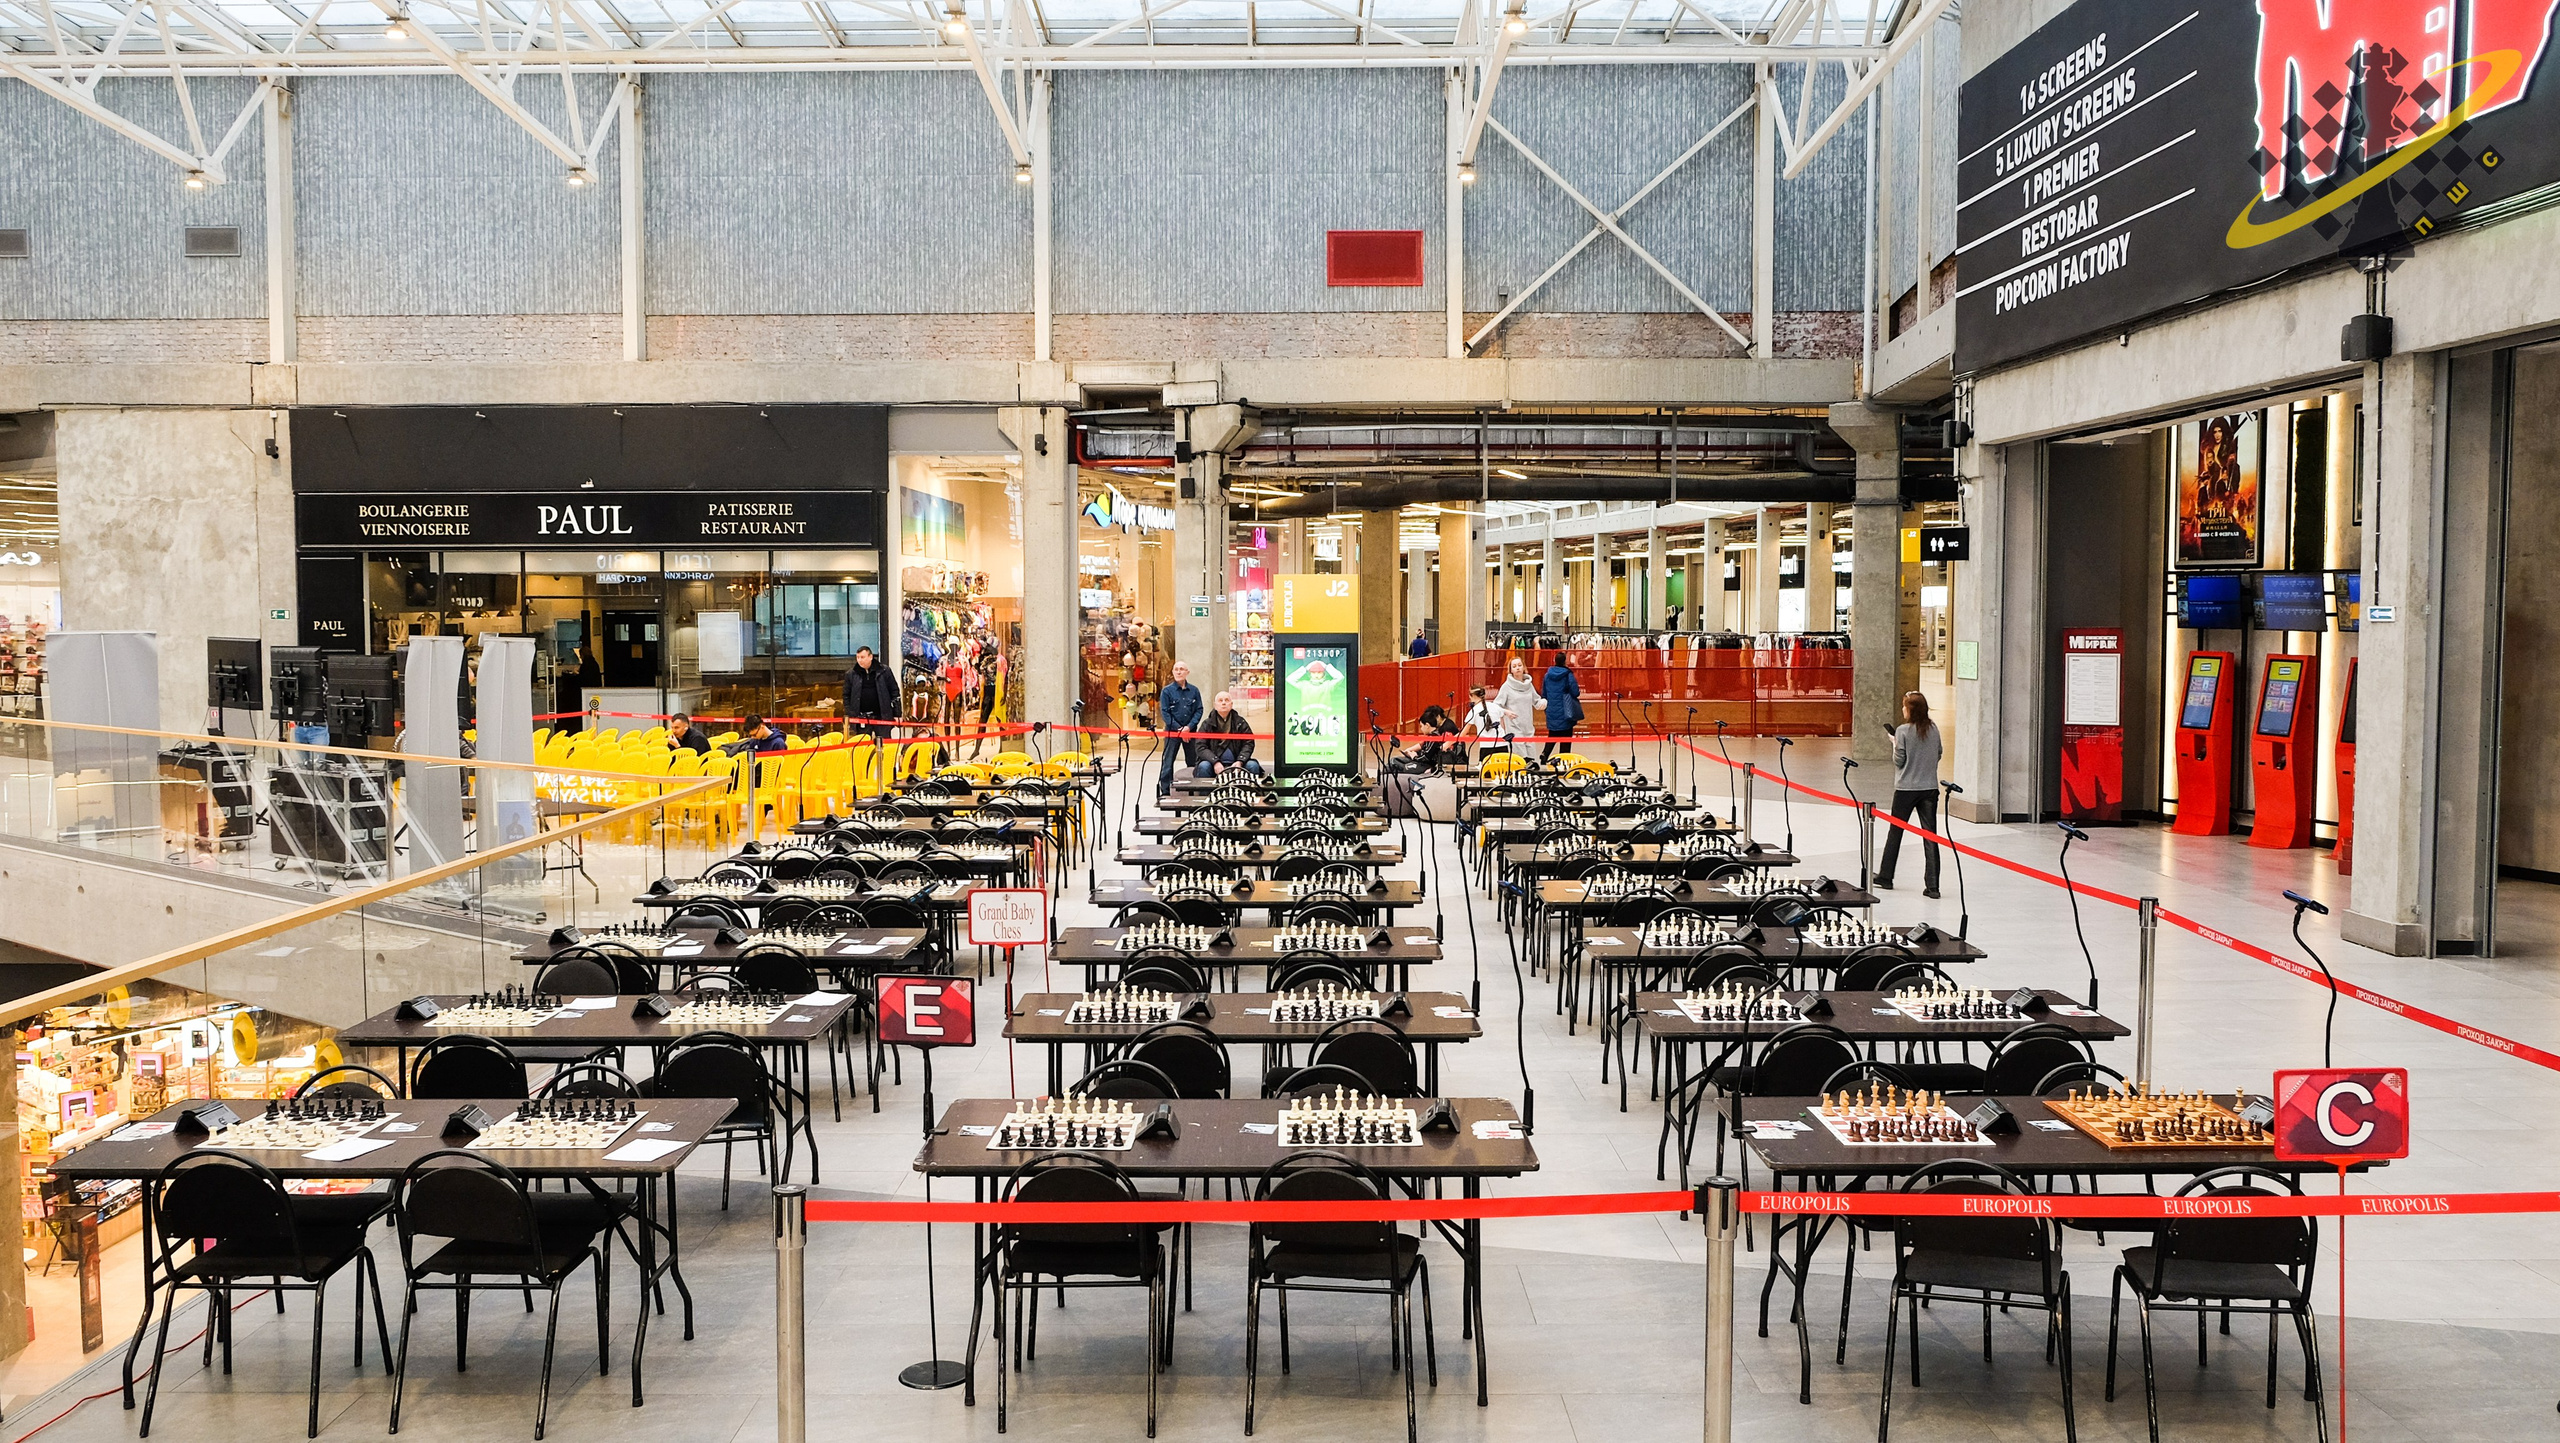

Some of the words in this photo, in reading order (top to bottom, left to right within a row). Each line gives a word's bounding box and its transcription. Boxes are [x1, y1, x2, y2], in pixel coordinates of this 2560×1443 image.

[2020, 79, 2036, 115] 16
[2038, 32, 2107, 104] SCREENS
[1995, 147, 2004, 177] 5
[2006, 111, 2062, 172] LUXURY
[2062, 67, 2136, 139] SCREENS
[2022, 178, 2030, 209] 1
[2033, 142, 2100, 205] PREMIER
[2022, 194, 2098, 258] RESTOBAR
[1995, 262, 2058, 316] POPCORN
[2060, 231, 2131, 291] FACTORY
[359, 504, 470, 518] BOULANGERIE
[537, 504, 633, 535] PAUL
[708, 503, 794, 516] PATISSERIE
[360, 523, 471, 537] VIENNOISERIE
[700, 521, 807, 535] RESTAURANT
[1947, 540, 1959, 548] WC
[1325, 580, 1349, 597] J2
[1283, 580, 1293, 628] EUROPOLIS
[313, 620, 345, 631] PAUL
[978, 902, 1008, 921] Grand
[1010, 902, 1036, 925] Baby
[993, 921, 1022, 939] Chess
[2198, 926, 2215, 941] ПРОХОД
[2215, 933, 2233, 947] ЗАКРЫТ
[2271, 955, 2291, 971] ПРОХОД
[2291, 964, 2312, 978] ЗАКРЫТ
[905, 985, 944, 1036] E
[2356, 989, 2379, 1006] ПРОХОД
[2379, 999, 2404, 1014] ЗАКРЫТ
[2457, 1025, 2485, 1045] ПРОХОД
[2485, 1035, 2515, 1053] ЗАКРЫТ
[2316, 1081, 2375, 1147] C
[1760, 1195, 1850, 1211] EUROPOLIS
[1963, 1198, 2052, 1214] EUROPOLIS
[2163, 1199, 2252, 1215] EUROPOLIS
[2361, 1197, 2450, 1213] EUROPOLIS
